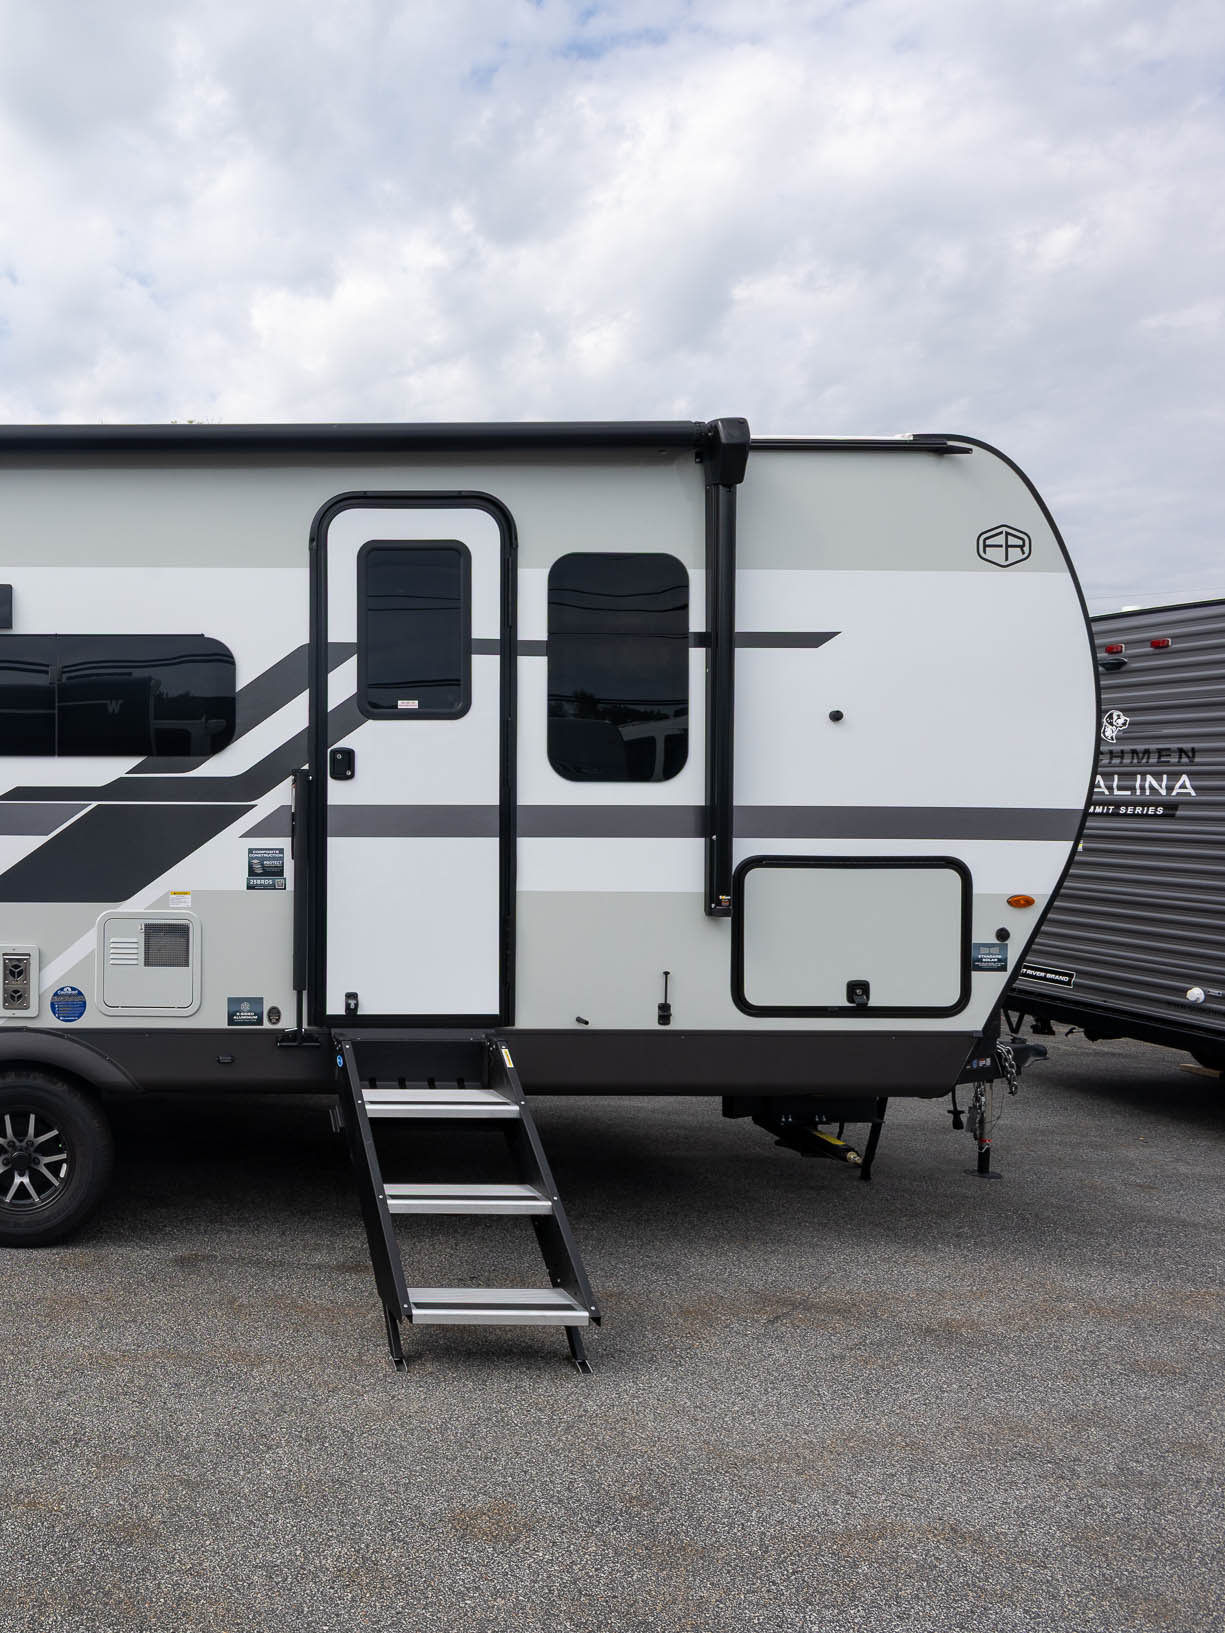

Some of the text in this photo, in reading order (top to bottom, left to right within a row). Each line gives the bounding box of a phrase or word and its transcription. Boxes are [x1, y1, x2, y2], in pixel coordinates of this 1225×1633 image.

[1099, 747, 1196, 764] HMEN
[1119, 806, 1164, 815] SERIES
[1046, 973, 1069, 982] BRAND
